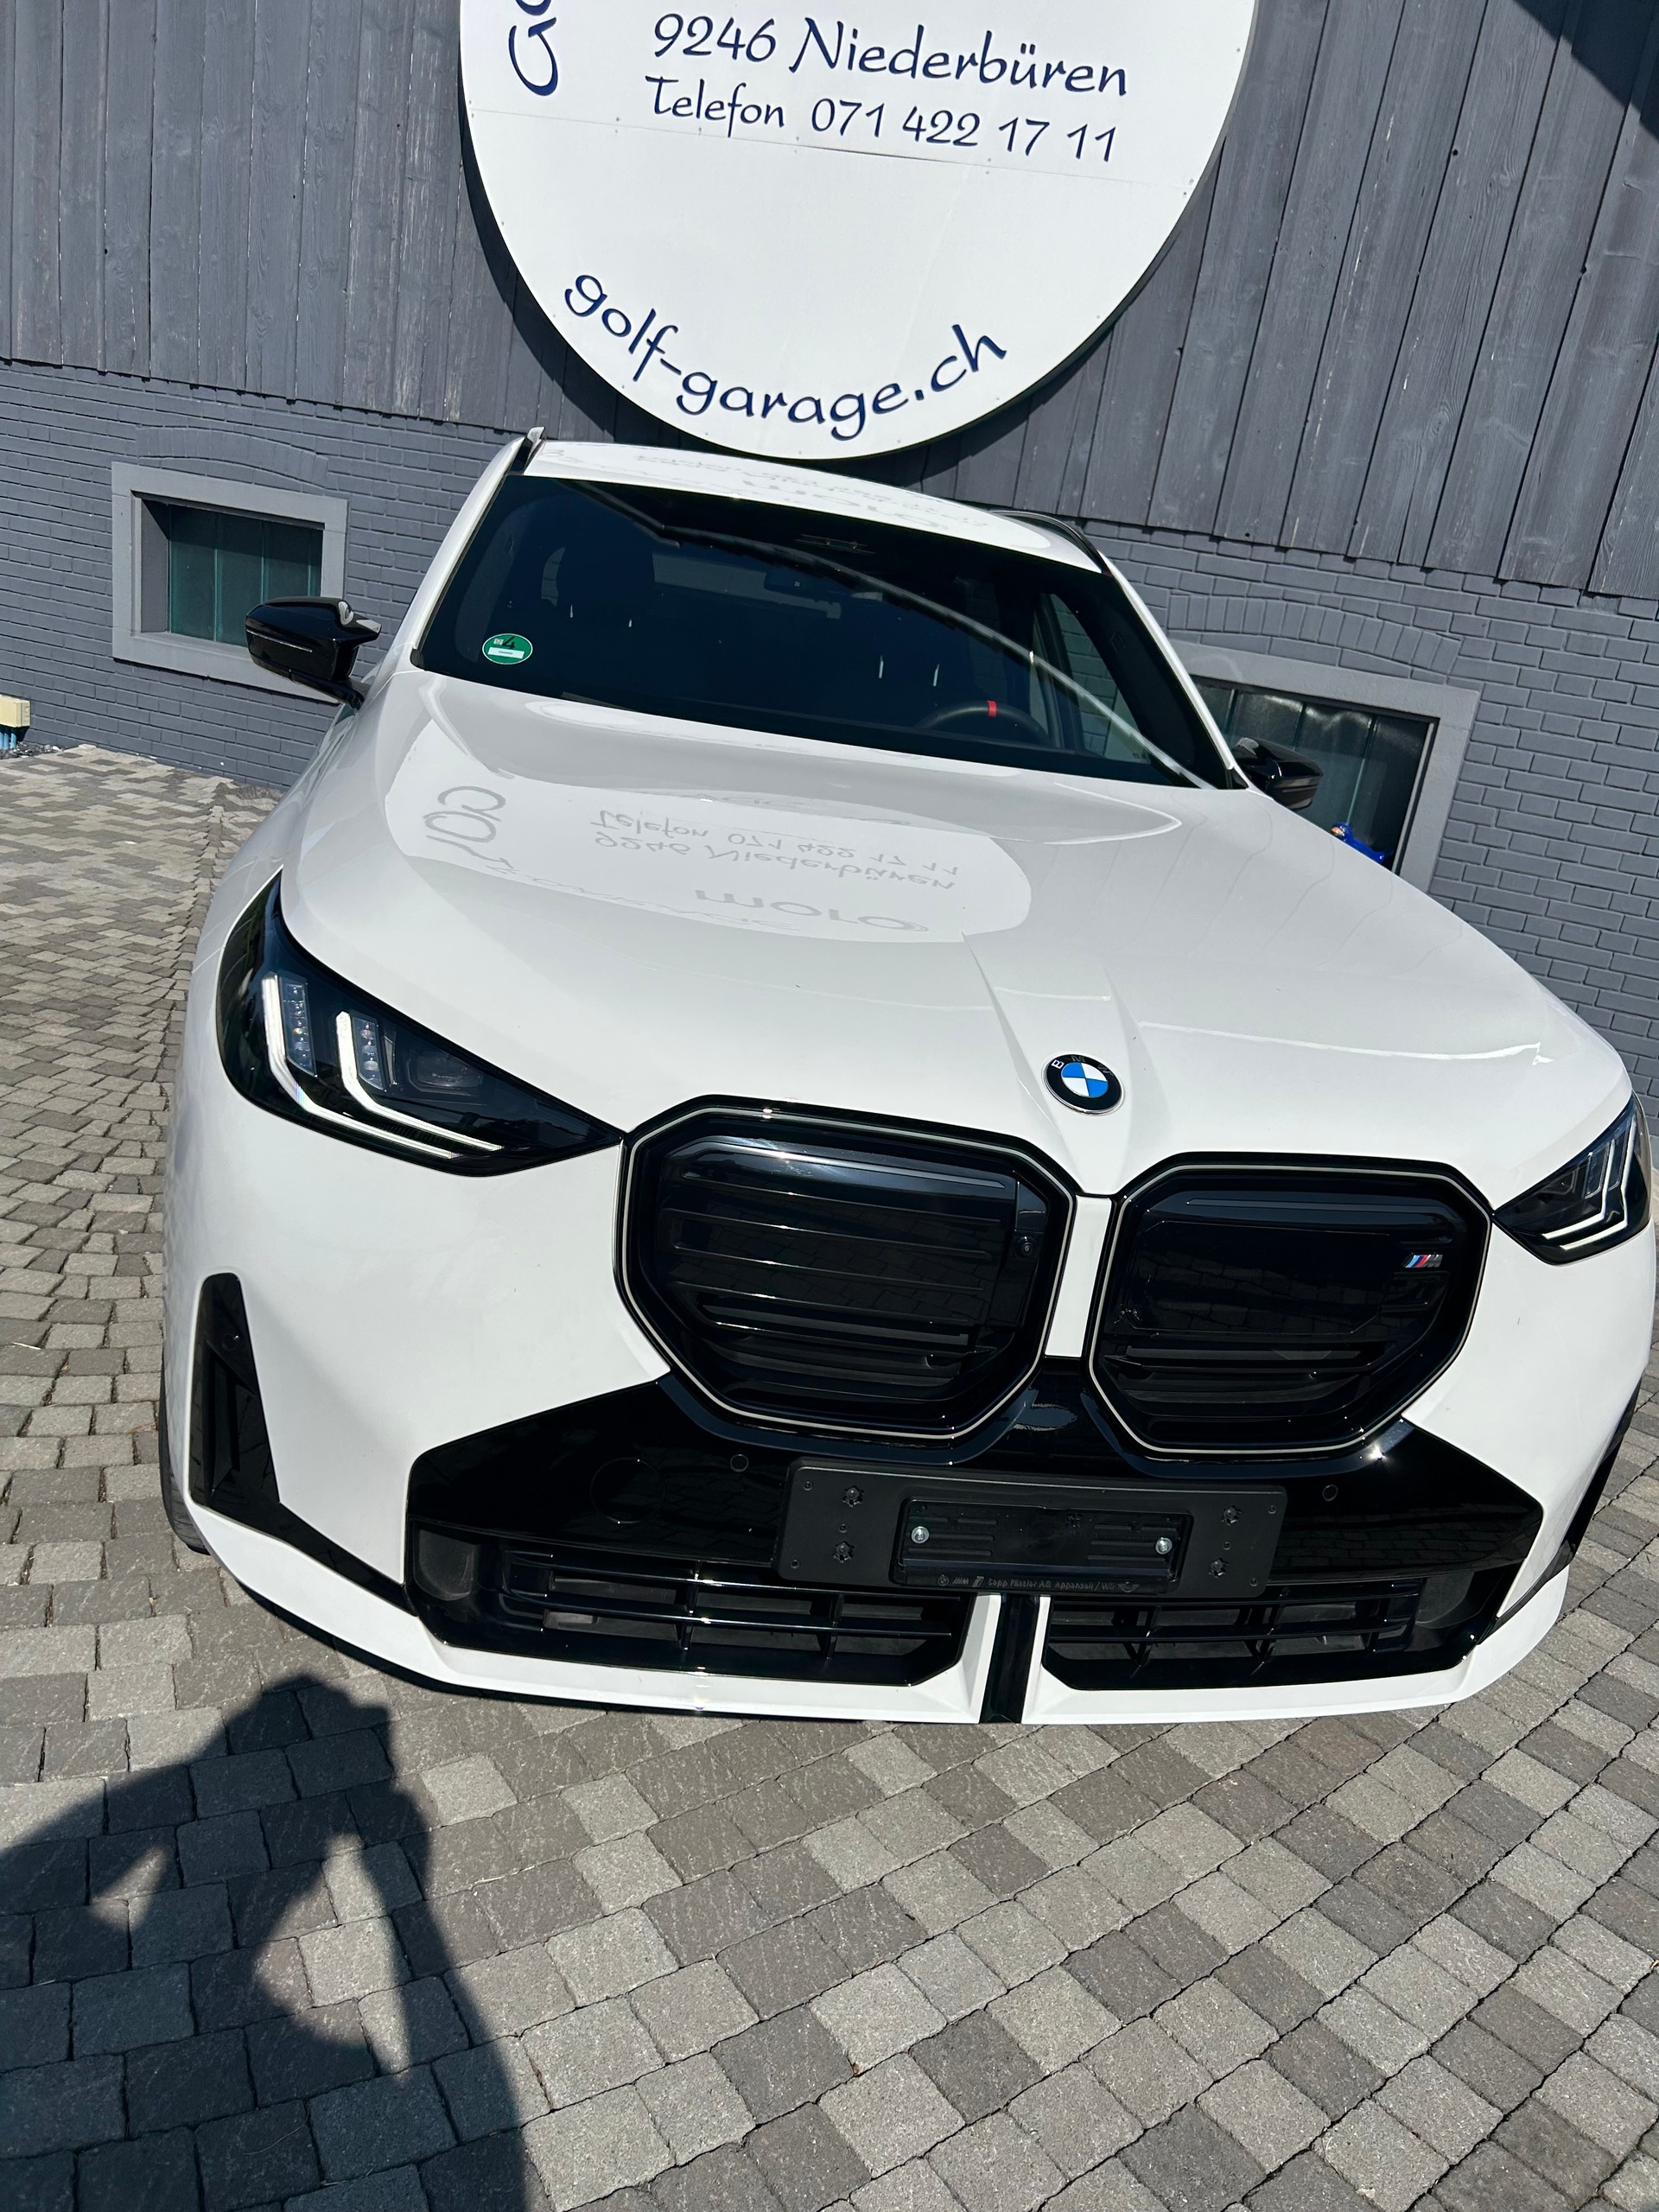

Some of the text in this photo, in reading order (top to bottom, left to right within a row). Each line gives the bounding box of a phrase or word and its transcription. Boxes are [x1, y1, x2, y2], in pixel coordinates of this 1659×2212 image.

[654, 13, 1127, 97] 9246 Niederbüren
[645, 75, 1116, 162] Telefon 071 422 17 11
[564, 274, 1007, 442] golf-garage.ch
[502, 635, 516, 649] 4
